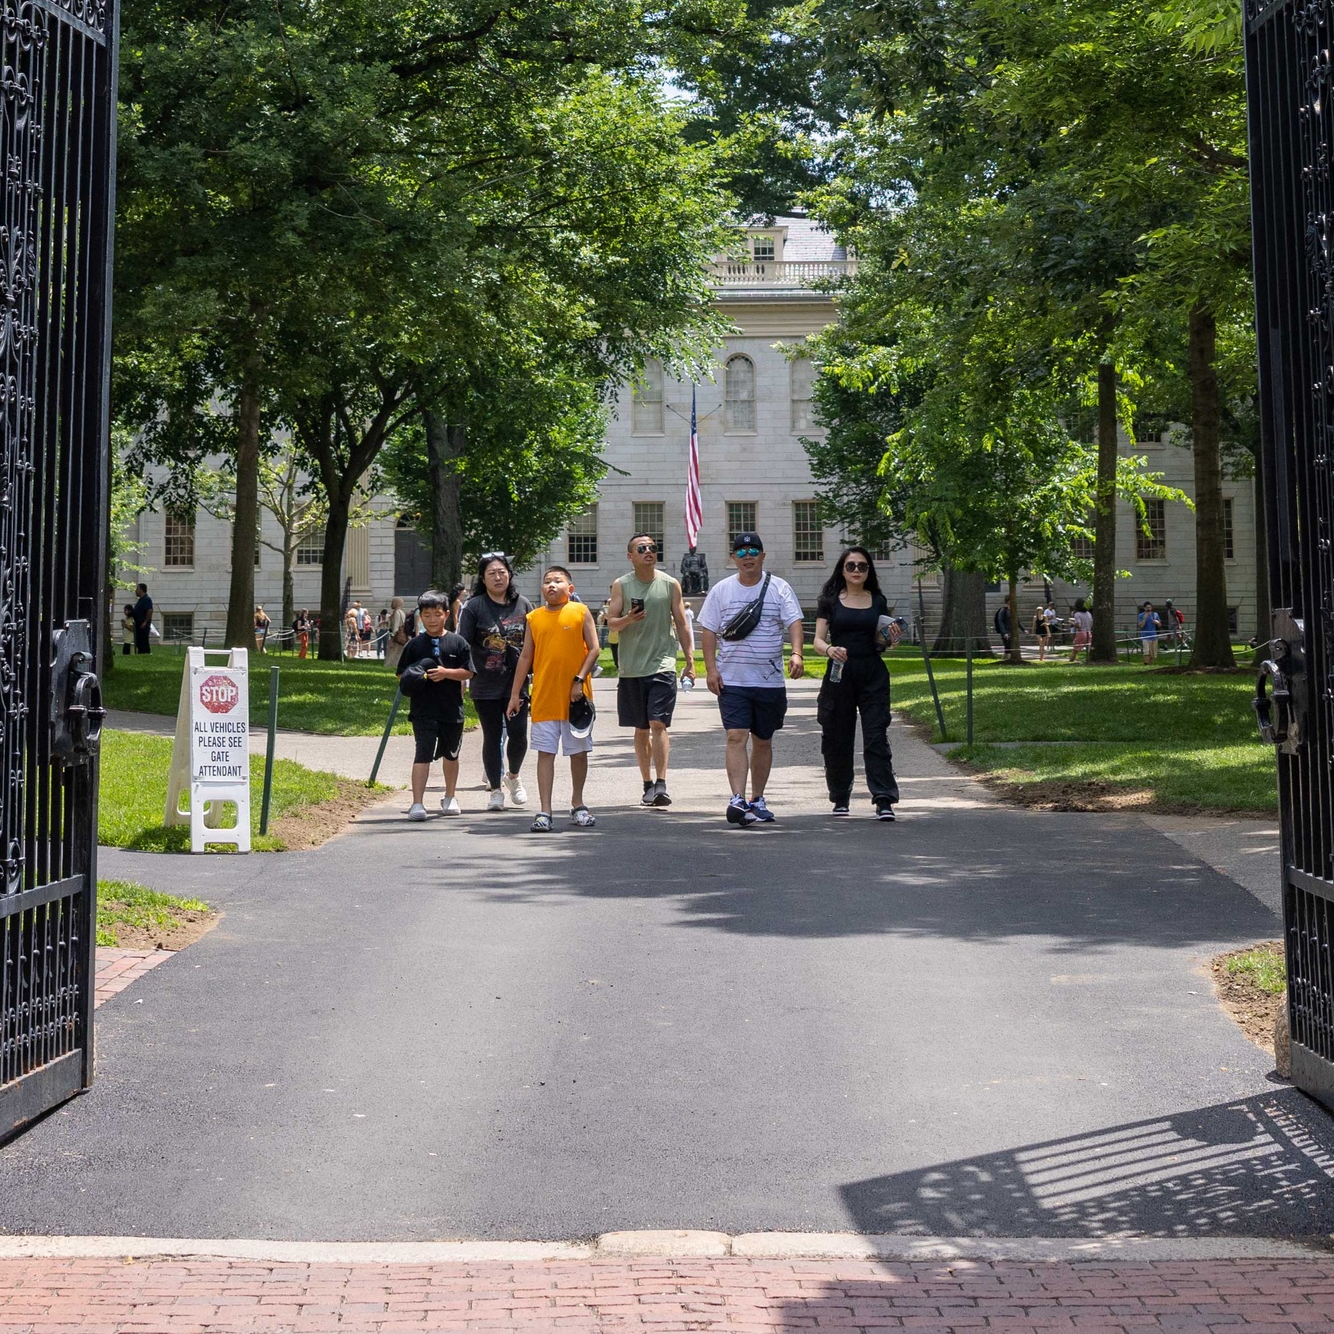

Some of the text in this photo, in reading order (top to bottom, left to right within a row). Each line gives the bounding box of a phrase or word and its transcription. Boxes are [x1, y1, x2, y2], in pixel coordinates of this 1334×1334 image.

[202, 686, 236, 702] STOP
[194, 722, 246, 733] ALL VEHICLES
[198, 736, 242, 747] PLEASE SEE
[211, 751, 229, 762] GATE
[199, 765, 242, 776] ATTENDANT
